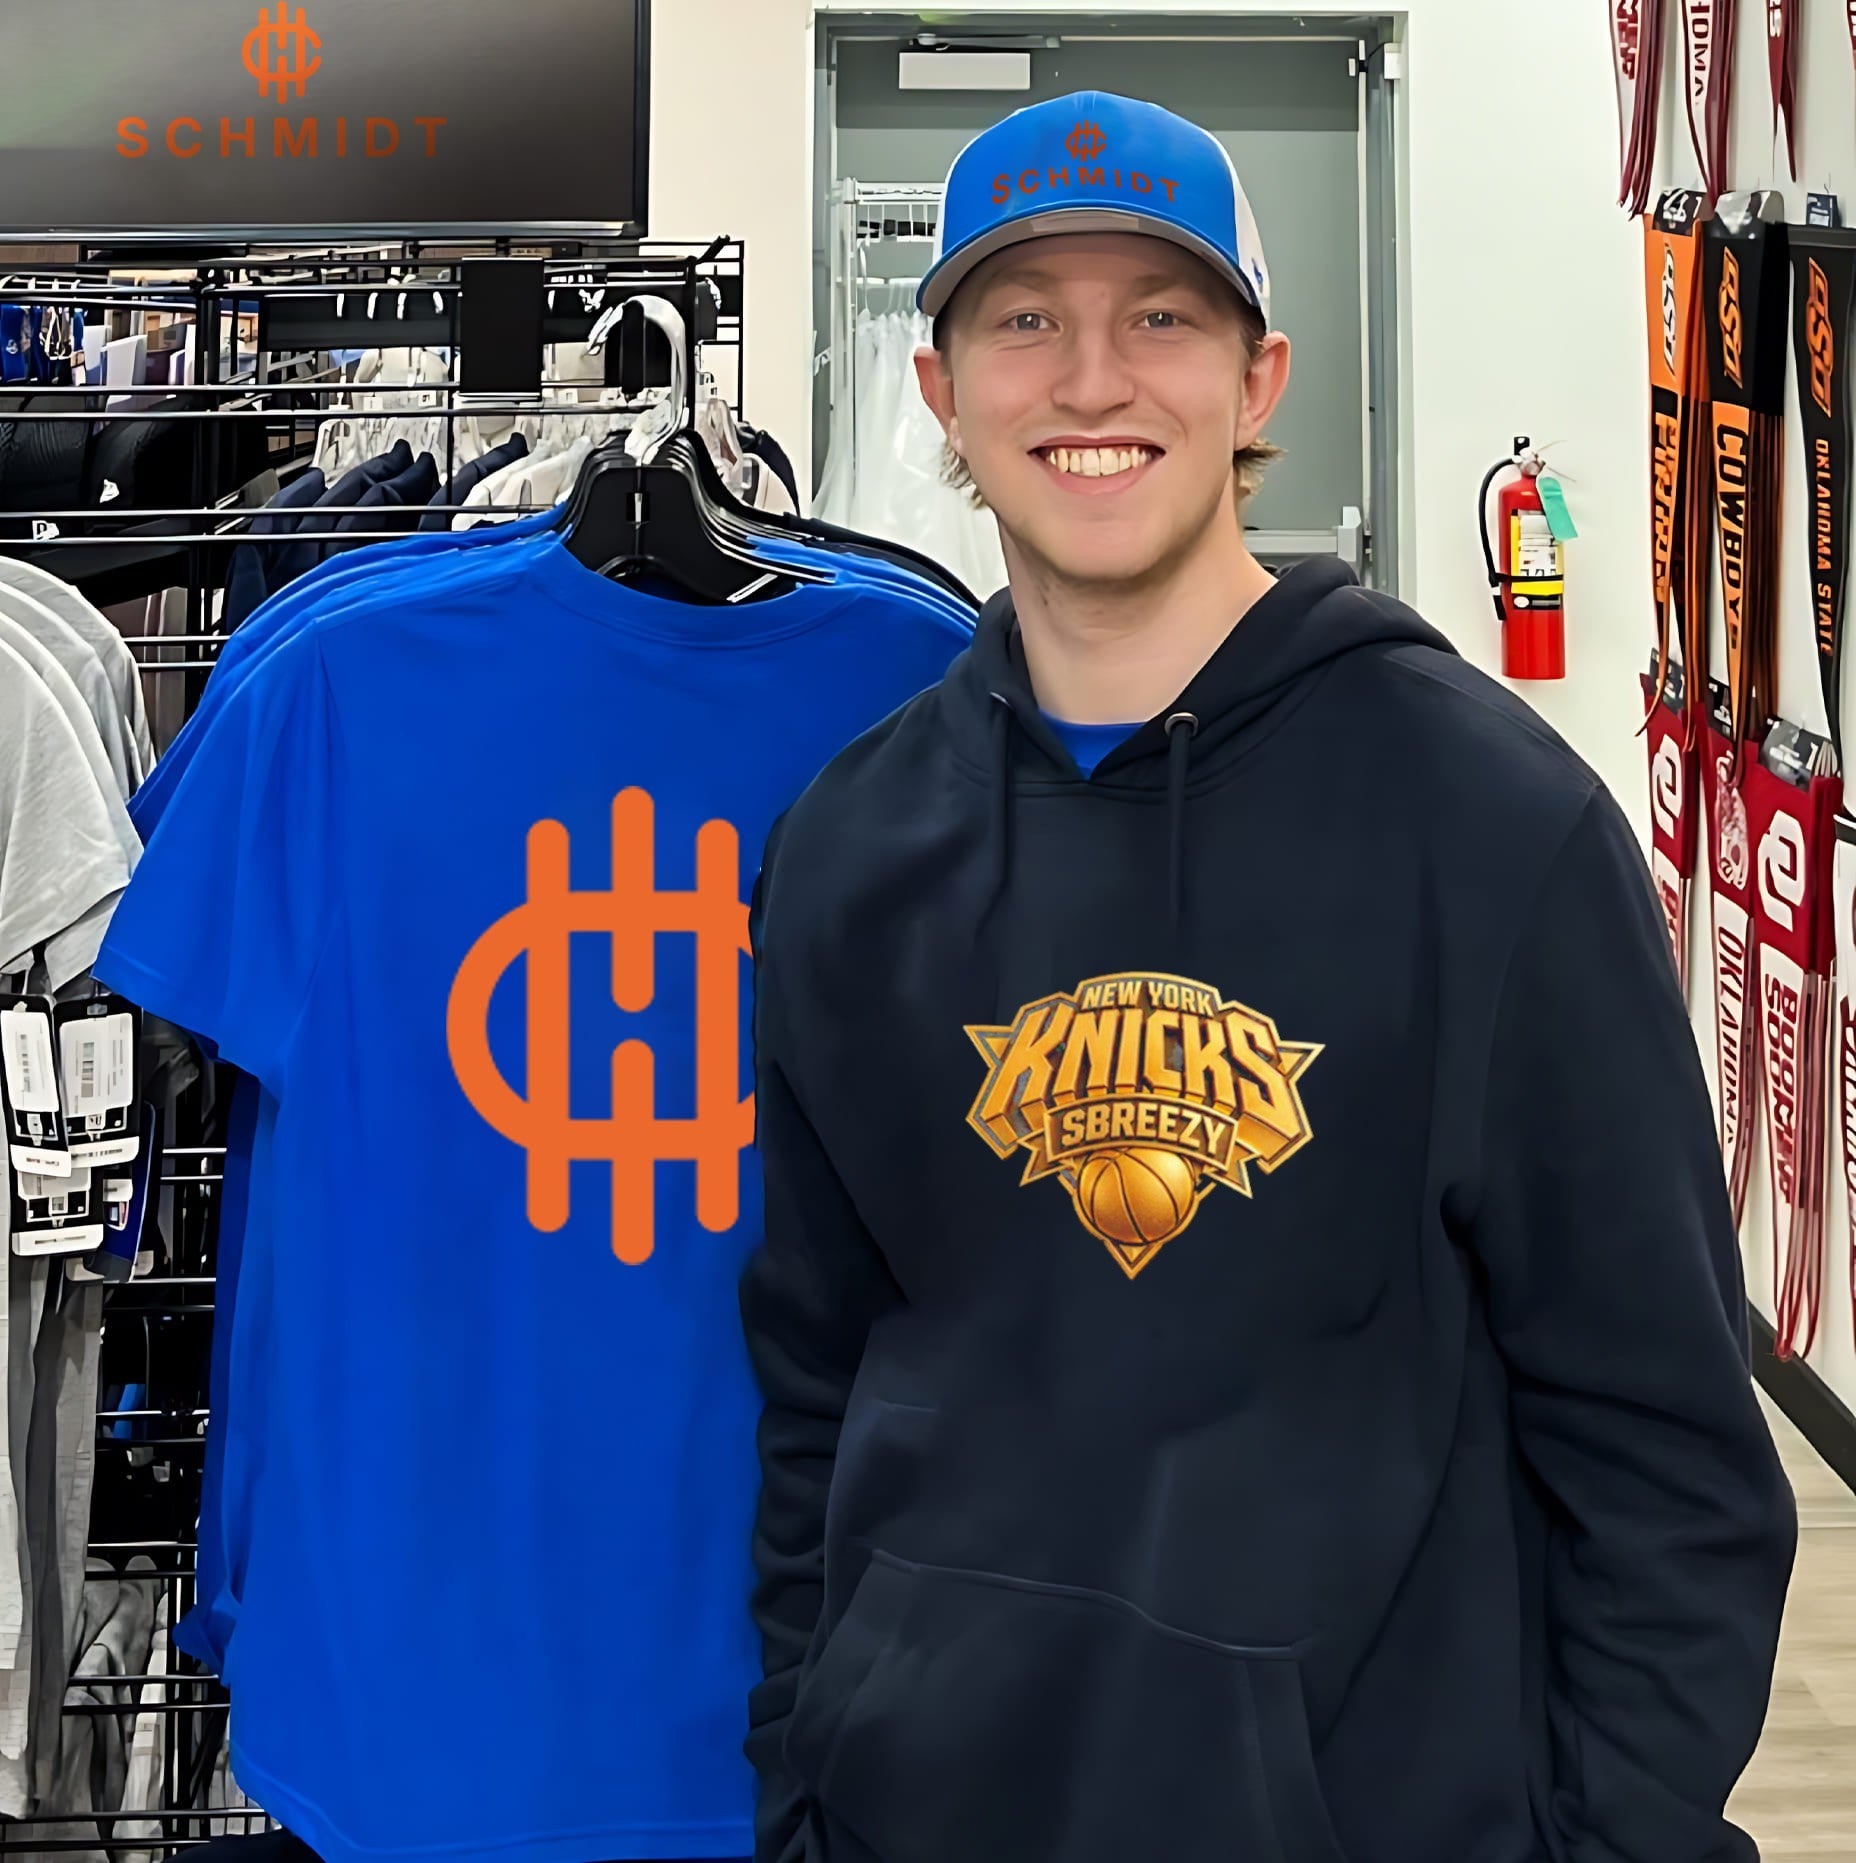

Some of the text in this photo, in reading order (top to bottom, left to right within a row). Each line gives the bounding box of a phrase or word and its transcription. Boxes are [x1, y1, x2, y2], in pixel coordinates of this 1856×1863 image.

[116, 117, 447, 158] SCHMIDT
[991, 167, 1179, 205] SCHMIDT
[1815, 438, 1833, 570] OKLAHOMA
[1081, 980, 1214, 1017] NEW YORK
[1718, 926, 1745, 1145] OKLAHOMA
[979, 1002, 1301, 1142] KNICKS
[1061, 1101, 1226, 1155] SBREEZY
